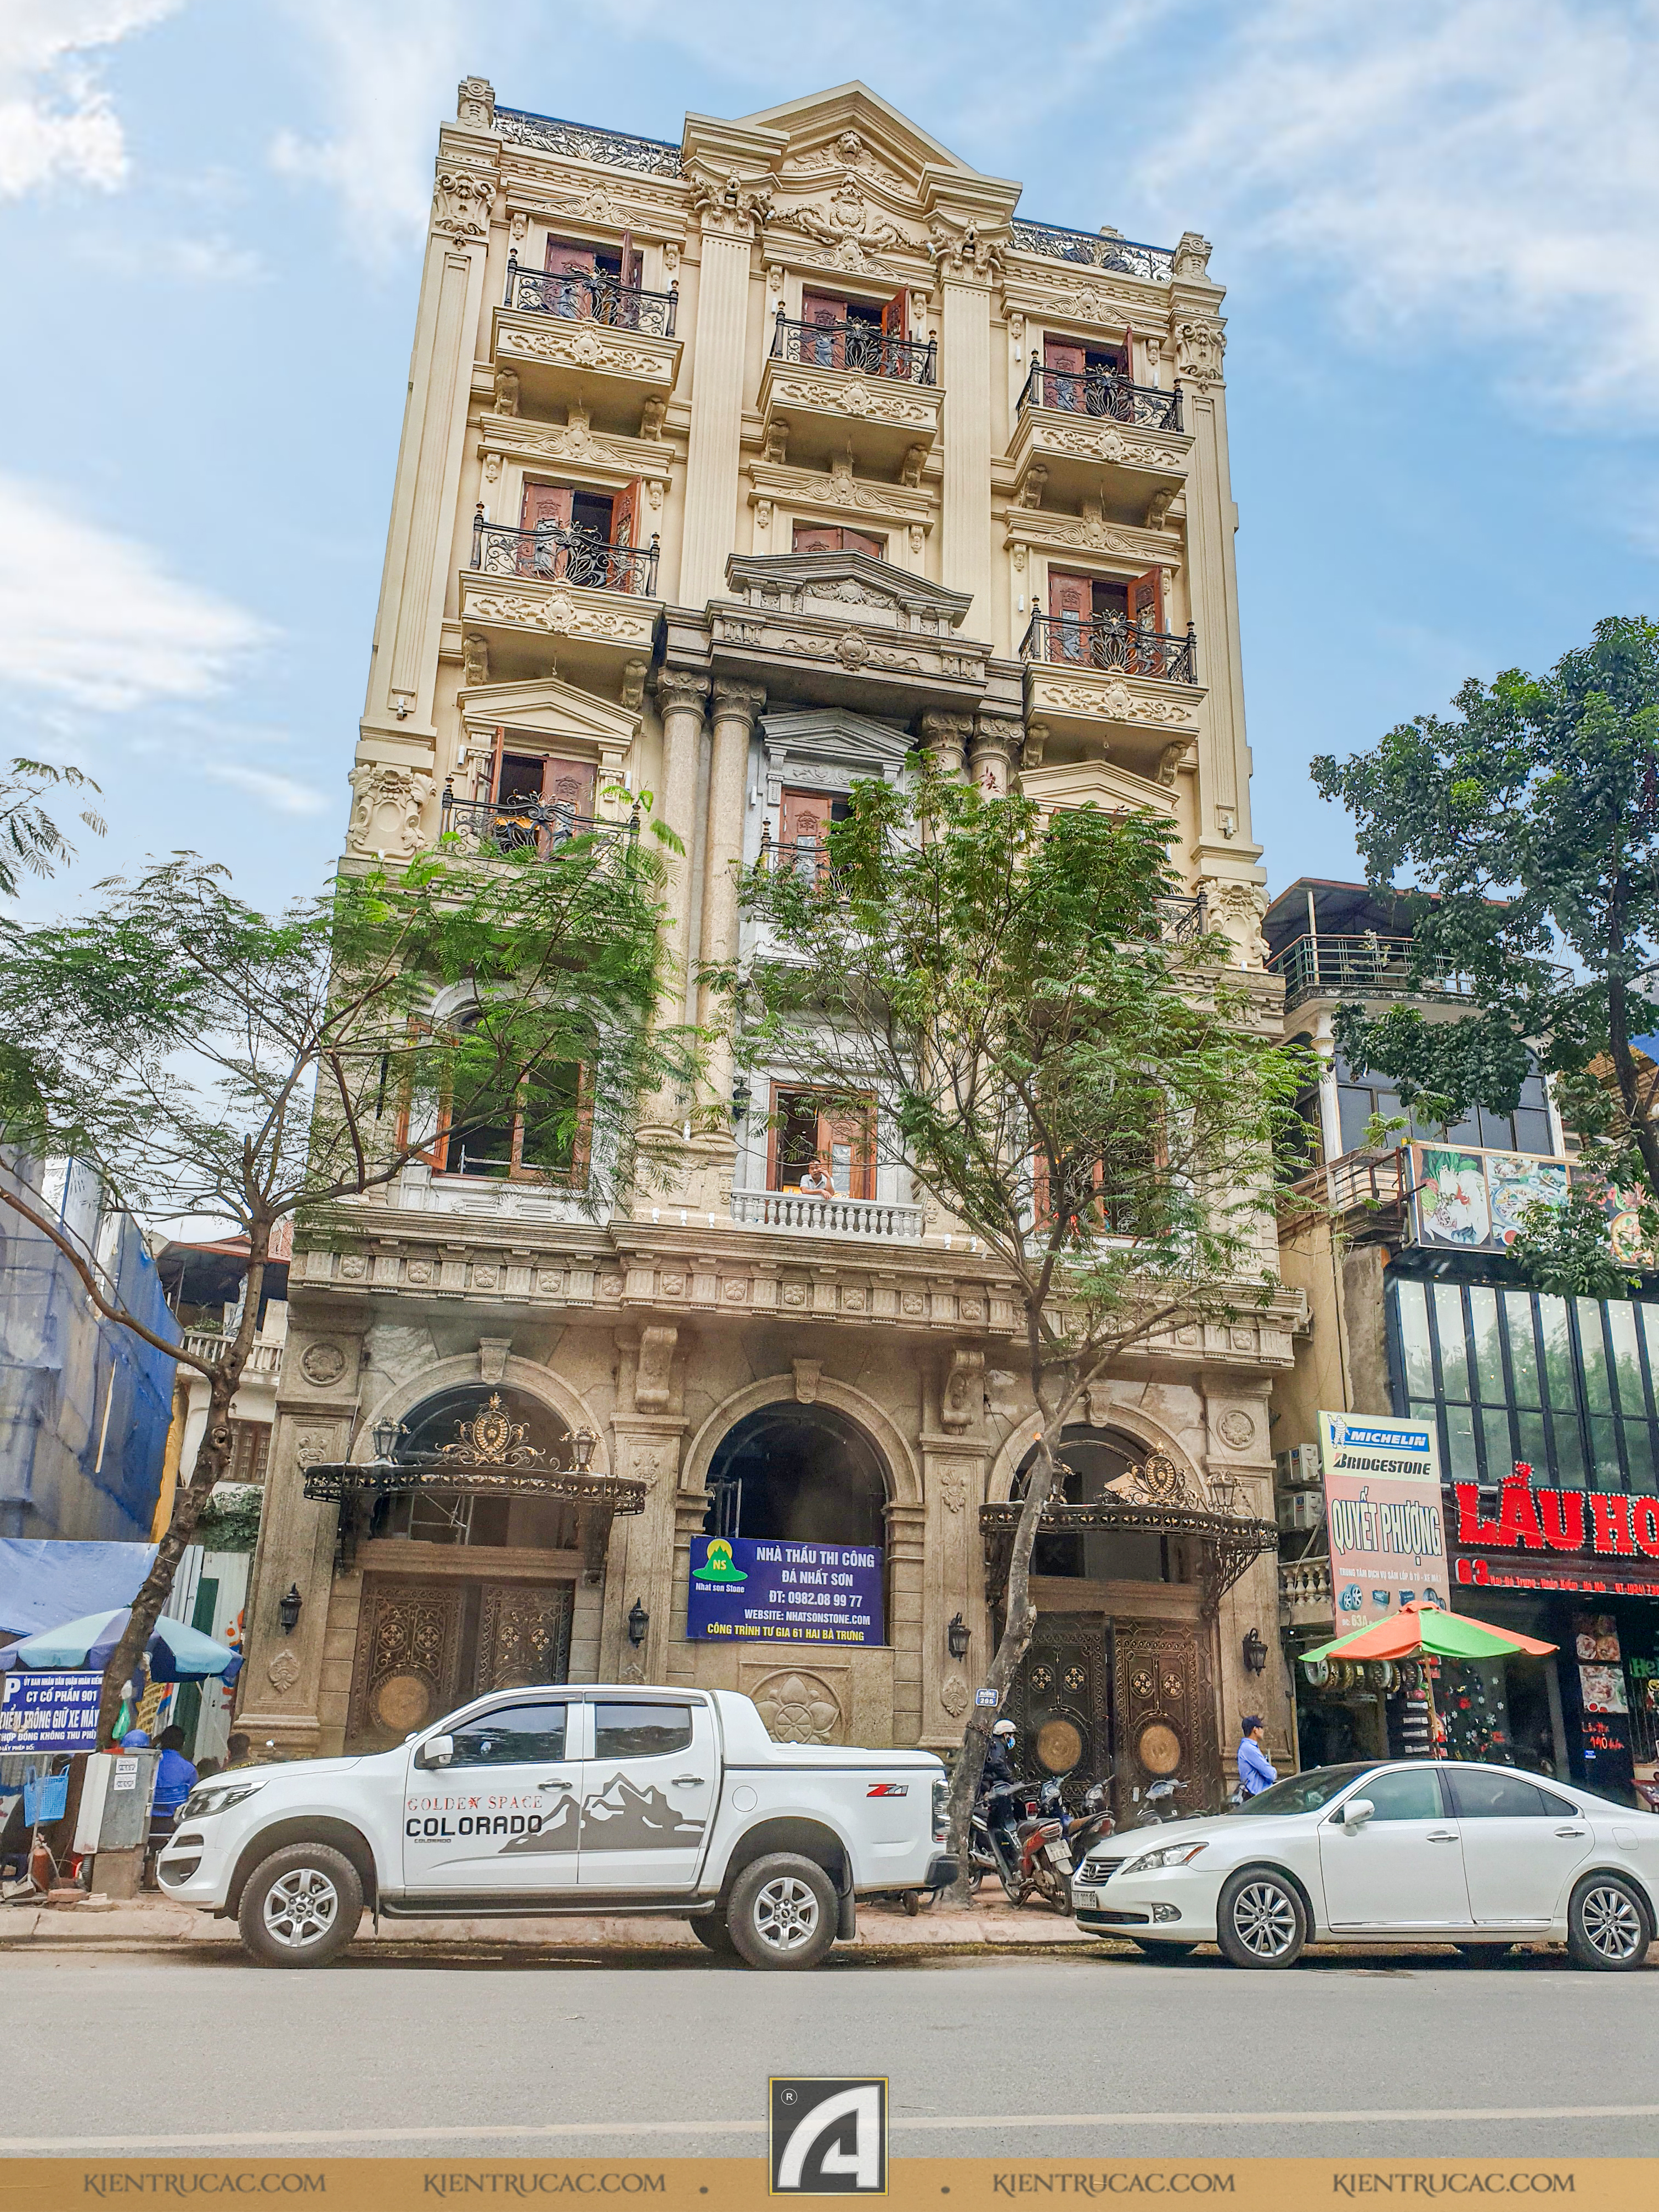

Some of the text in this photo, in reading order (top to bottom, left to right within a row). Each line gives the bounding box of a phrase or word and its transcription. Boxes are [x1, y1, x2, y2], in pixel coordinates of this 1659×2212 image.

[1350, 1431, 1426, 1446] MICHELIN
[1333, 1453, 1431, 1475] BRIDGESTONE
[1454, 1460, 1586, 1551] LẨU
[1331, 1486, 1442, 1566] QUYẾT PHƯỢNG
[713, 1559, 726, 1570] NS
[757, 1545, 782, 1562] NHÀ
[820, 1550, 838, 1565] THI
[842, 1550, 874, 1567] CÔNG
[782, 1568, 853, 1587] ĐÁ NHẤT SƠN
[1339, 1567, 1356, 1577] TRUNG
[696, 1583, 712, 1591] Nhat
[726, 1584, 745, 1593] Stone
[769, 1590, 862, 1607] ĐT: 0982.08 99 77
[744, 1609, 870, 1626] WEBSITE: NHATSONSTONE.COM
[707, 1622, 864, 1641] CÔNG TRÌNH TƯ GIA 61 HAI BÀ TRƯNG
[3, 1678, 21, 1703] P
[26, 1690, 38, 1703] CT
[81, 1690, 97, 1702] 901
[68, 1709, 81, 1728] XE
[81, 1705, 100, 1728] MÁY
[40, 1730, 65, 1741] KHÔNG
[67, 1731, 80, 1740] THU
[866, 1784, 909, 1797] Z71
[407, 1796, 543, 1810] GOLDEN SPACE
[406, 1815, 543, 1837] COLORADO
